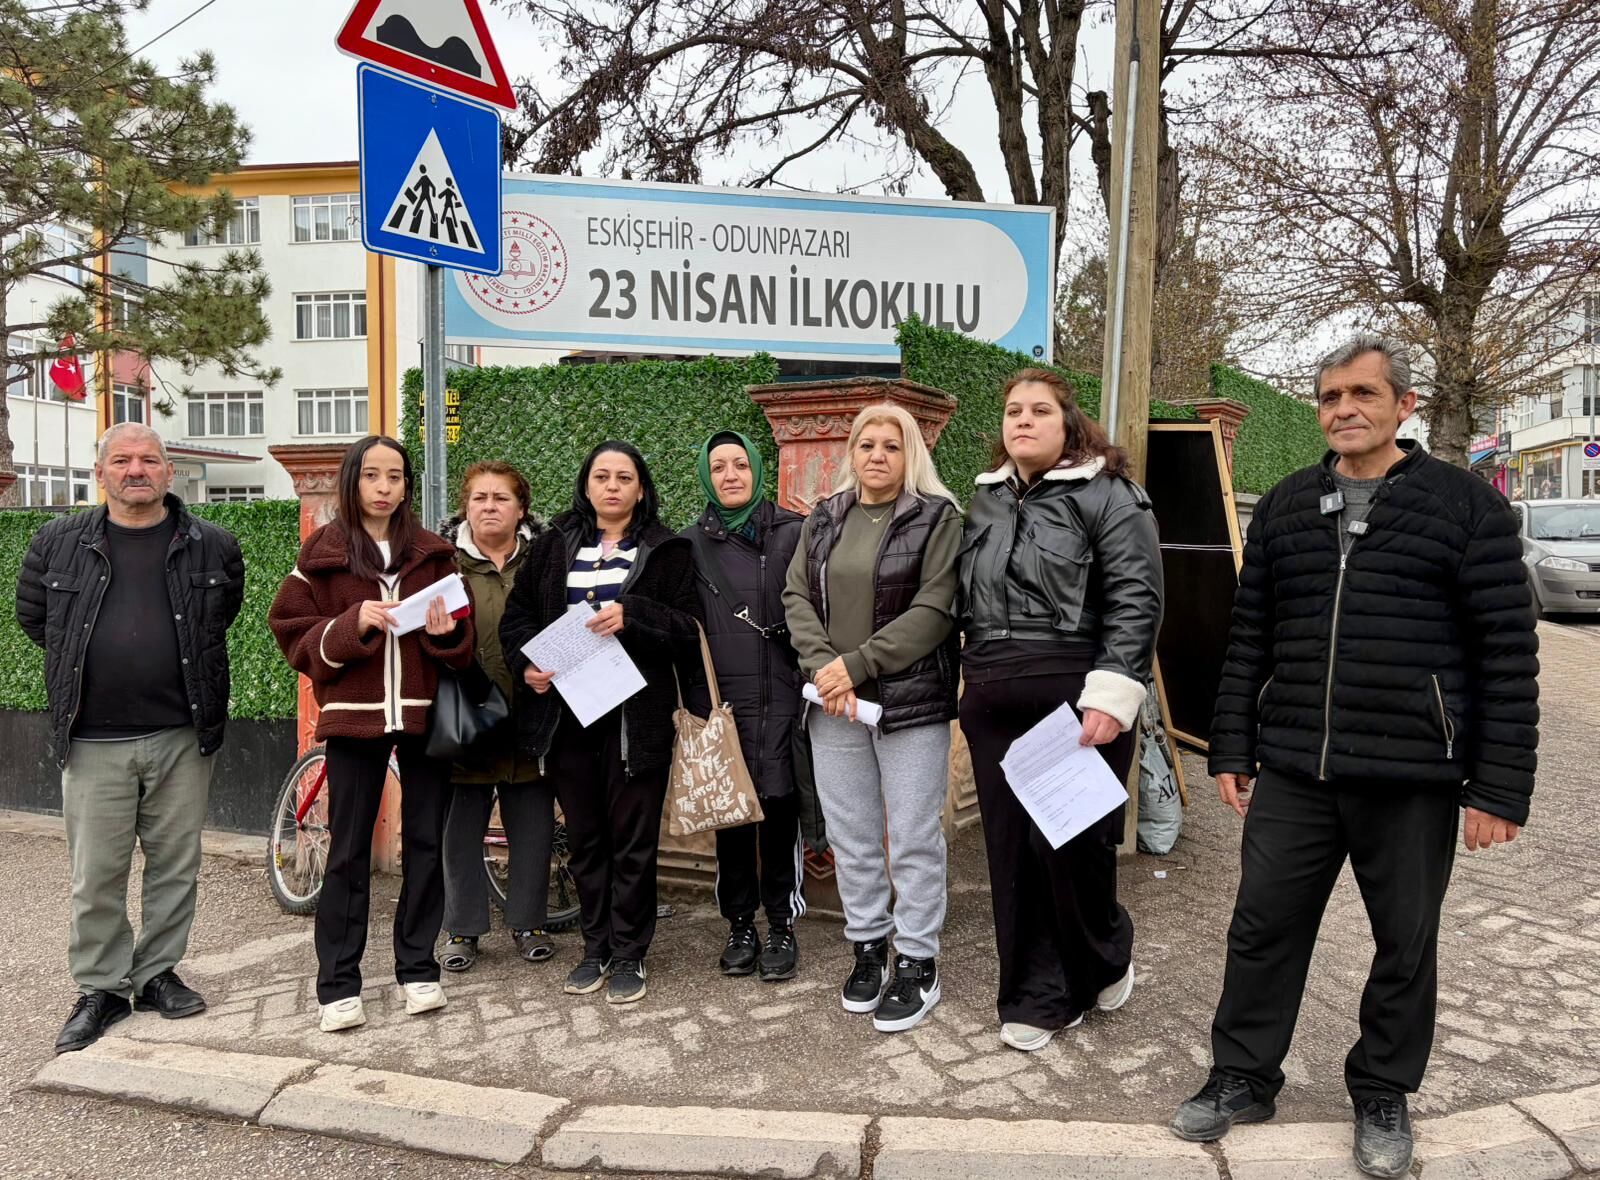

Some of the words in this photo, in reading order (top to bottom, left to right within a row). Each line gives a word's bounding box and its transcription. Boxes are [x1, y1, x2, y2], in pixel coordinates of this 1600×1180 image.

[587, 213, 694, 256] ESKİŞEHİR
[712, 223, 850, 258] ODUNPAZARI
[588, 268, 637, 320] 23
[651, 258, 776, 326] NİSAN
[790, 264, 981, 334] İLKOKULU
